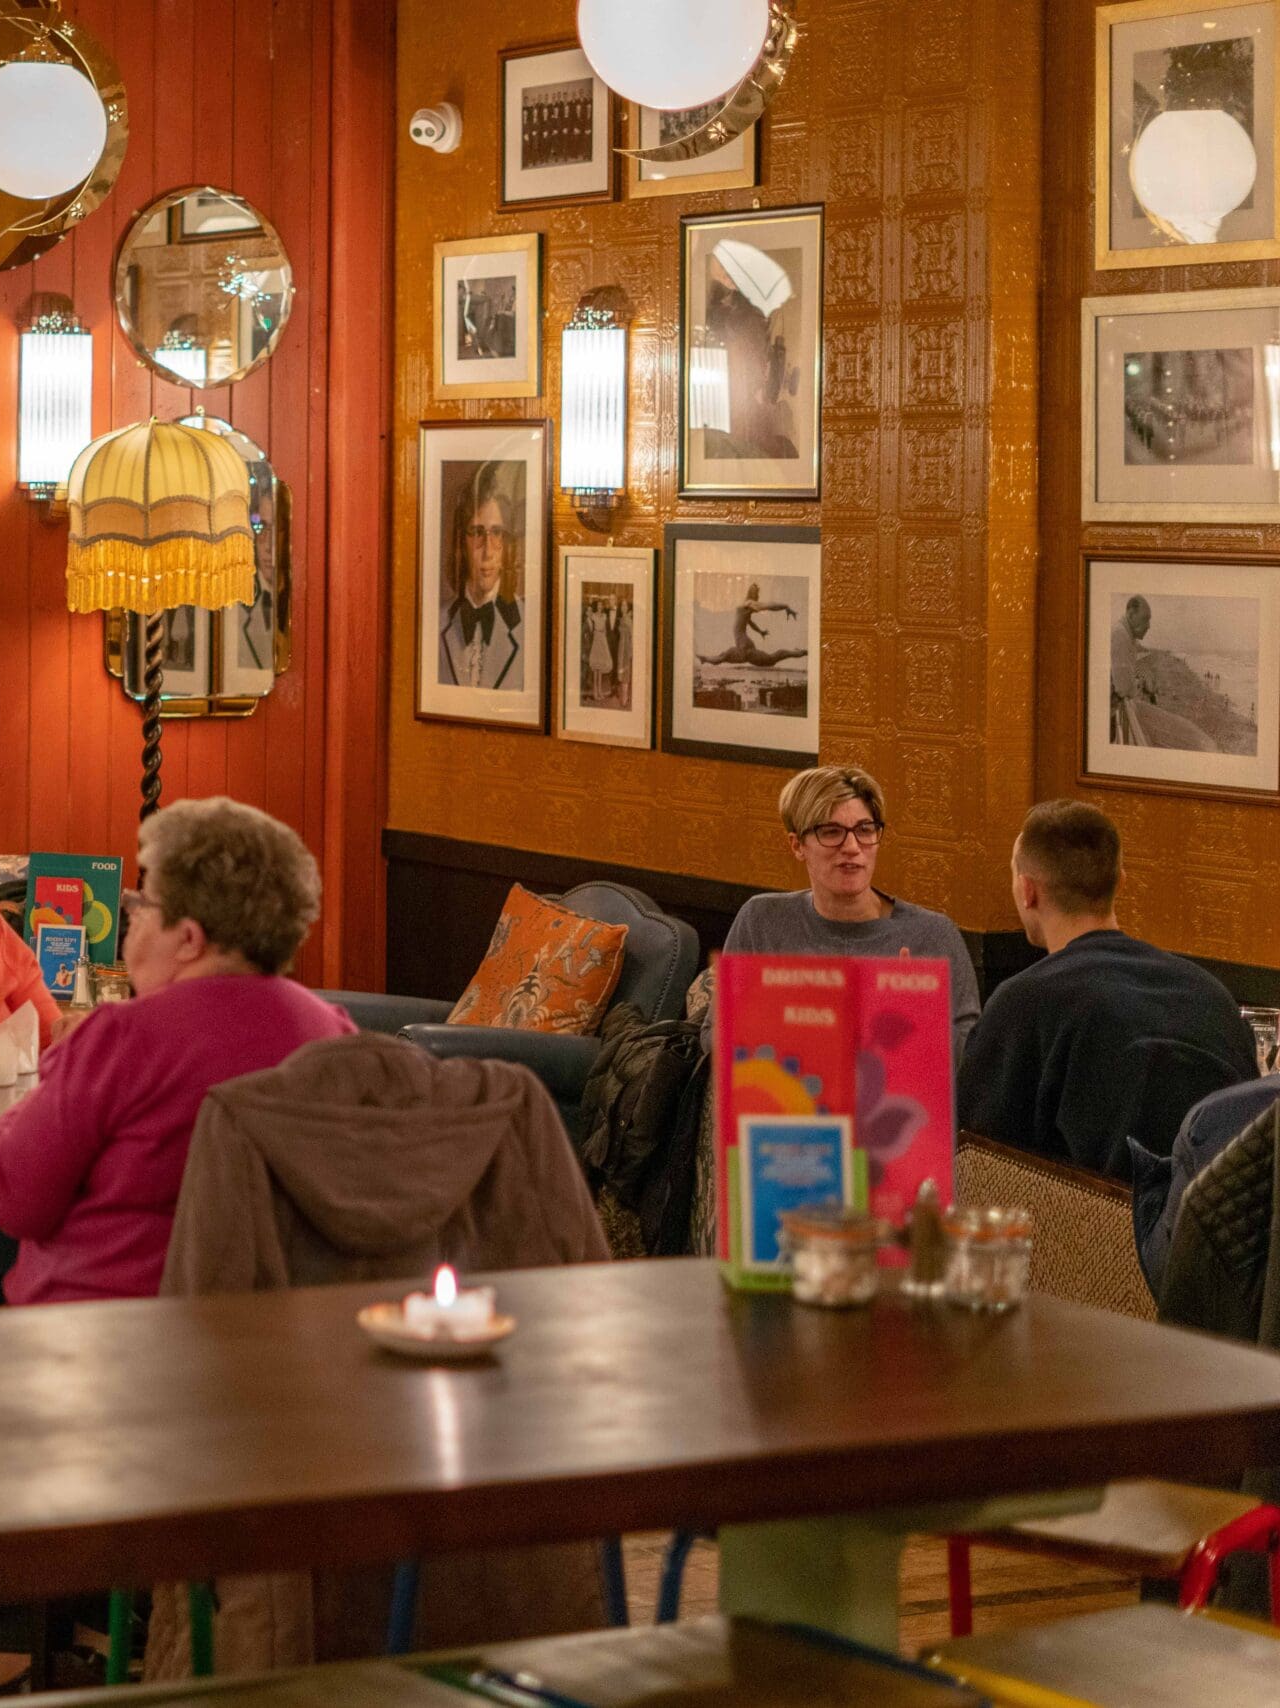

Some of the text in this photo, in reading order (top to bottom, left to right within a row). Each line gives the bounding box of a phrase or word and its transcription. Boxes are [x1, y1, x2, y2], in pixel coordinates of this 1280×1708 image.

[91, 862, 117, 871] FOOD
[56, 884, 80, 893] KIDS
[876, 973, 939, 991] FOOD
[783, 1006, 836, 1025] KIDS
